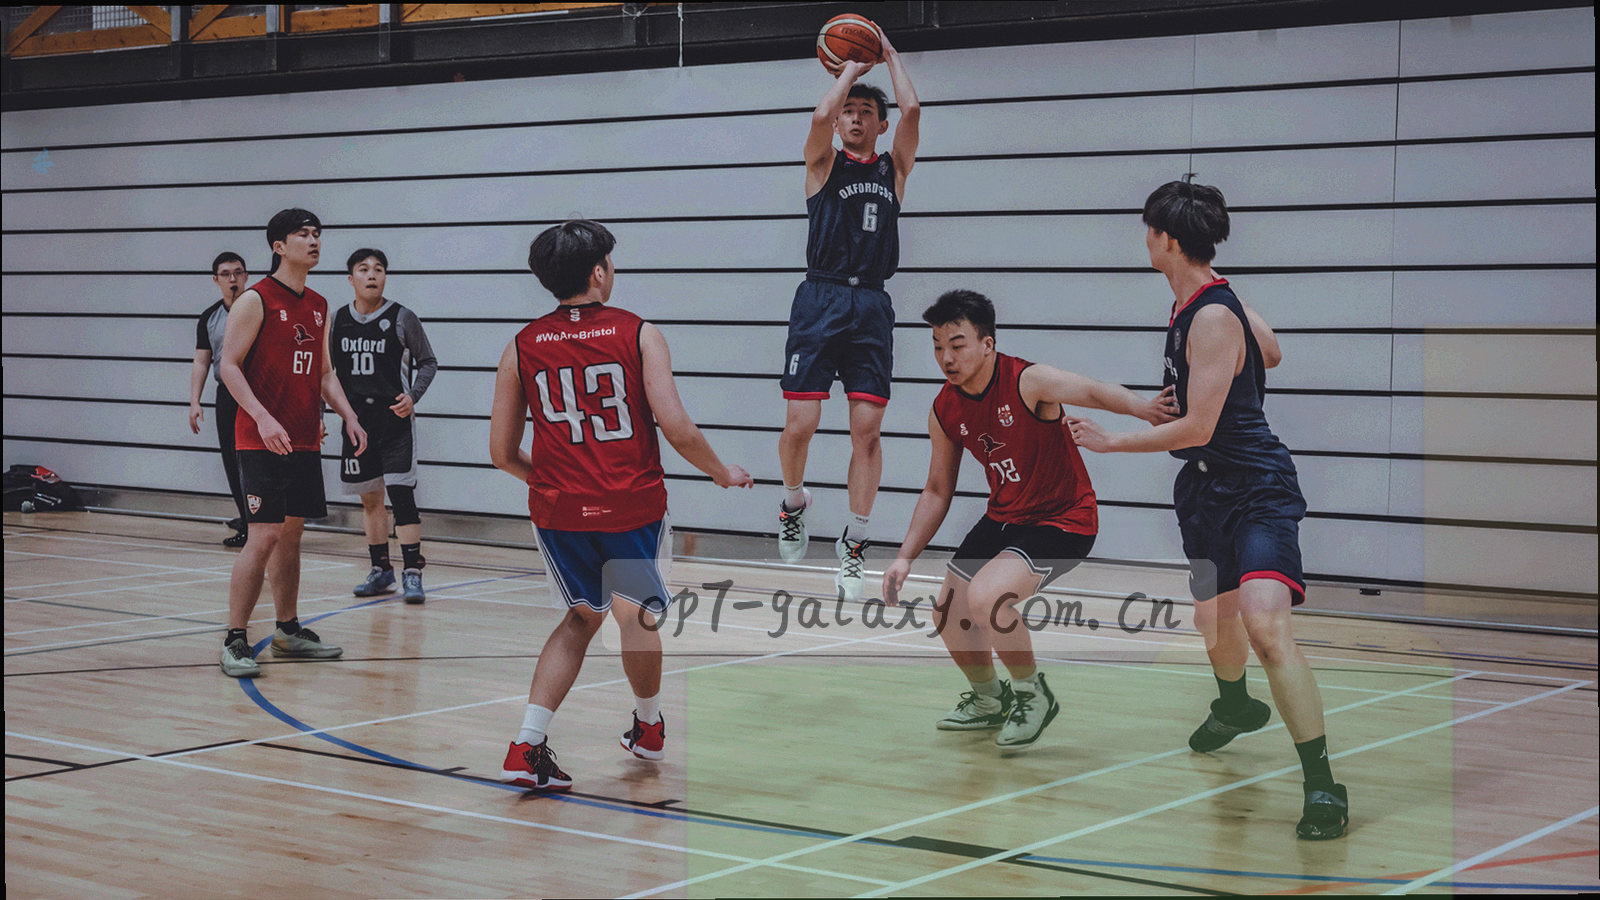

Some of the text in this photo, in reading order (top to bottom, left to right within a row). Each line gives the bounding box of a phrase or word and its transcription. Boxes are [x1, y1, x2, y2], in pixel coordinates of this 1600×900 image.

[862, 202, 878, 232] 6
[341, 337, 386, 353] Oxford
[535, 327, 616, 343] #WeAreBristol
[293, 351, 313, 375] 67
[351, 352, 375, 375] 10
[789, 353, 800, 376] 6
[534, 361, 634, 444] 43
[344, 458, 361, 475] 10
